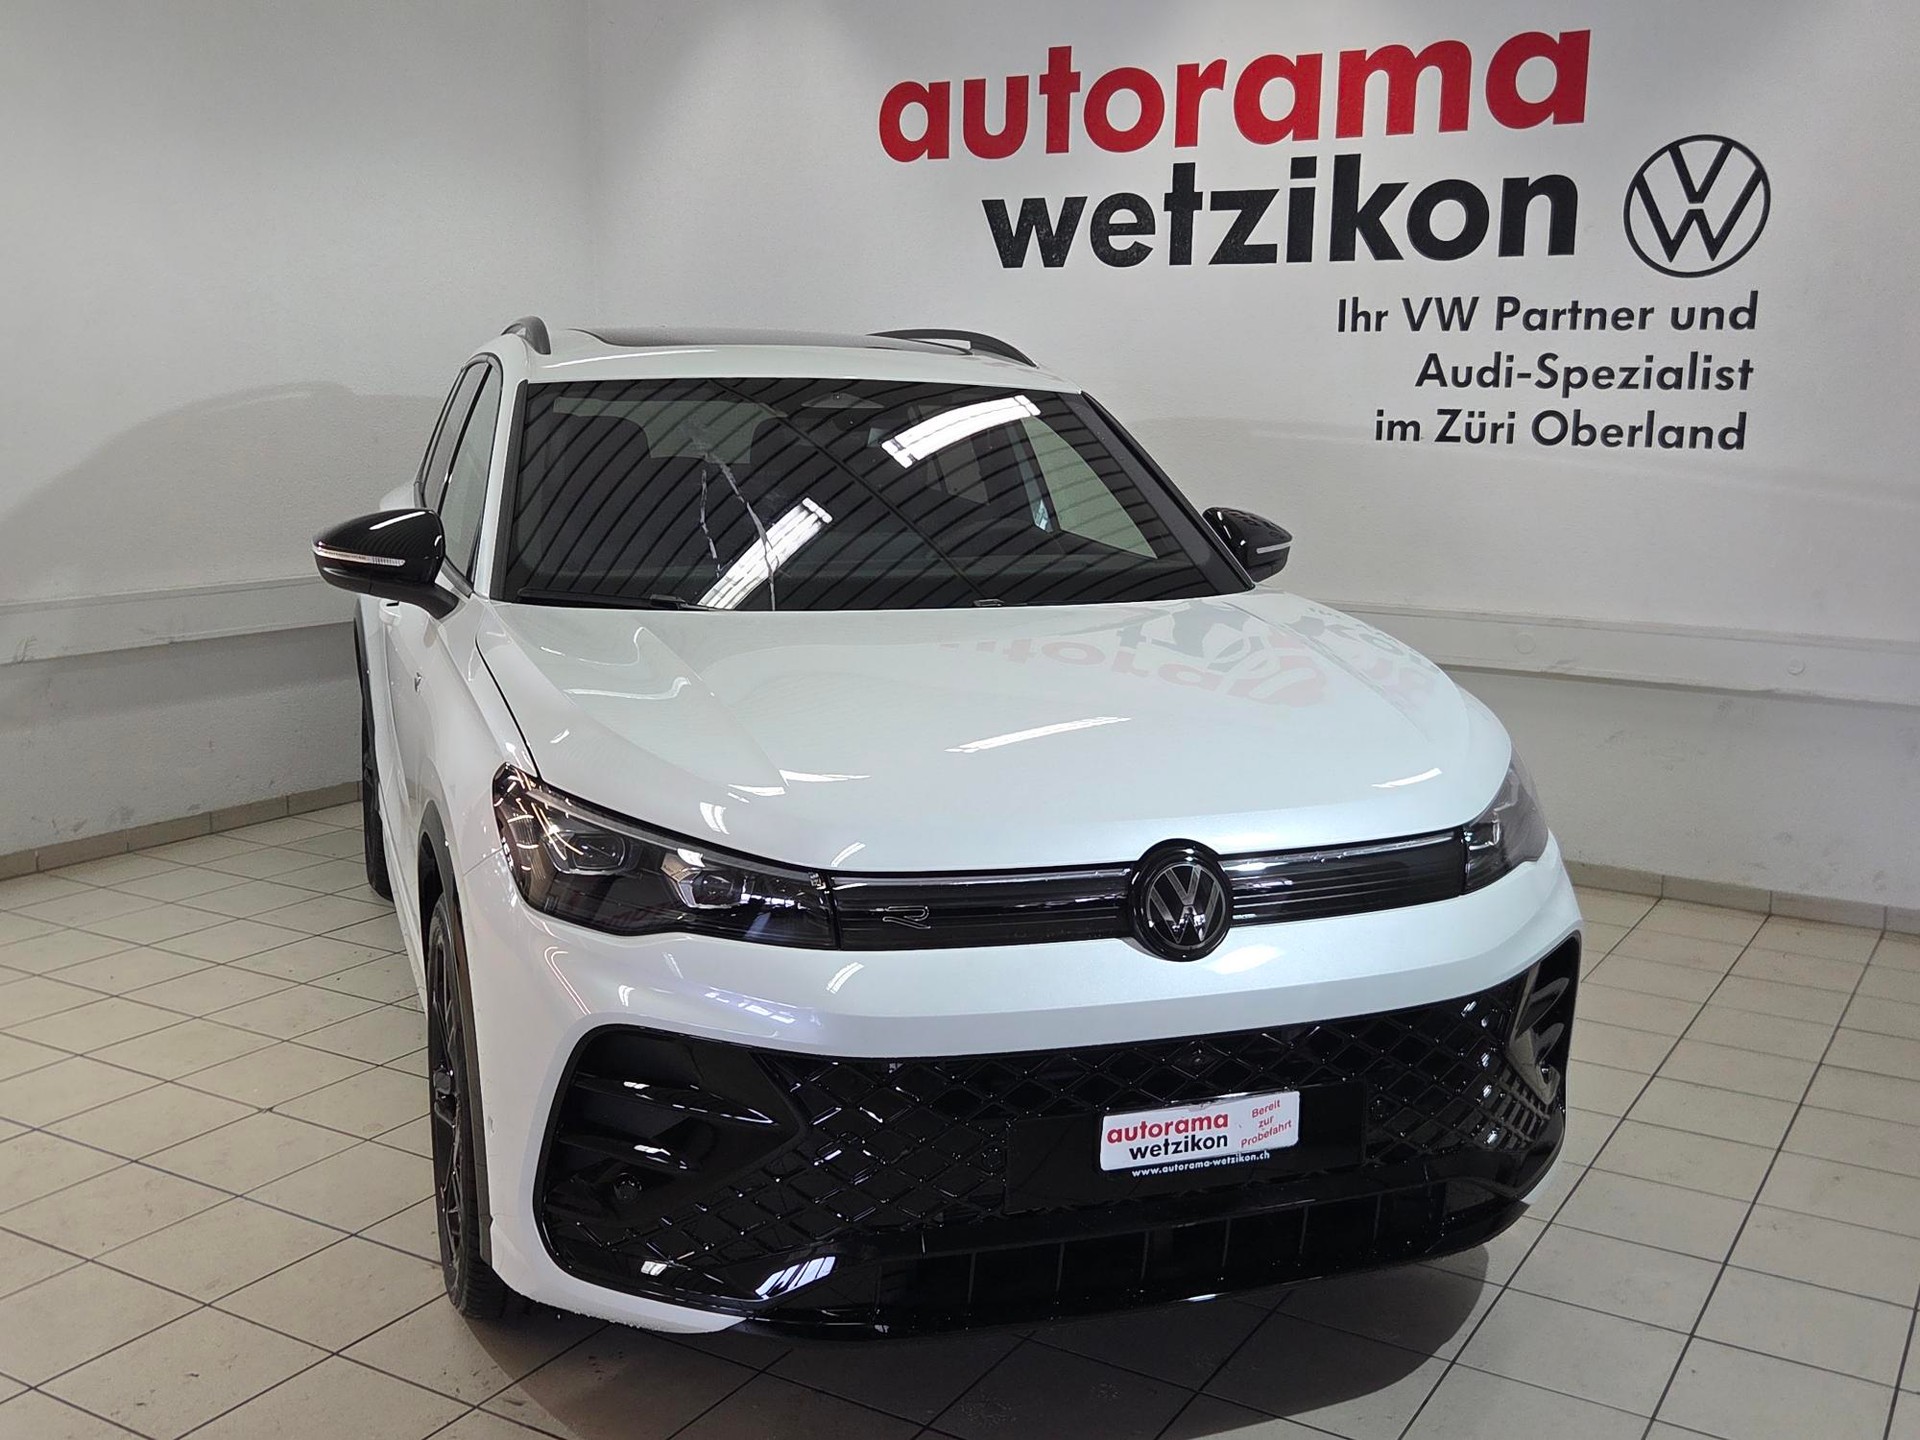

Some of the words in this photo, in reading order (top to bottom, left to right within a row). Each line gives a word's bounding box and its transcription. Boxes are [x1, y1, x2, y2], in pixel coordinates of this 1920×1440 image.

[878, 30, 1591, 162] autorama
[981, 154, 1579, 269] wetzikon
[1337, 297, 1389, 333] Ihr
[1401, 296, 1480, 332] VW
[1495, 297, 1655, 332] Partner
[1670, 291, 1759, 331] und
[1414, 352, 1754, 399] Audi-Spezialist
[1375, 409, 1421, 442] im
[1434, 408, 1516, 445] Züri
[1531, 408, 1747, 451] Oberland
[1251, 1099, 1281, 1118] Bereit
[1258, 1115, 1274, 1128] zur
[1107, 1113, 1228, 1144] autorama
[1240, 1119, 1292, 1148] Probefahrt
[1129, 1134, 1228, 1160] wetzikon
[1131, 1150, 1270, 1178] www.autorama-wetzikon.ch
